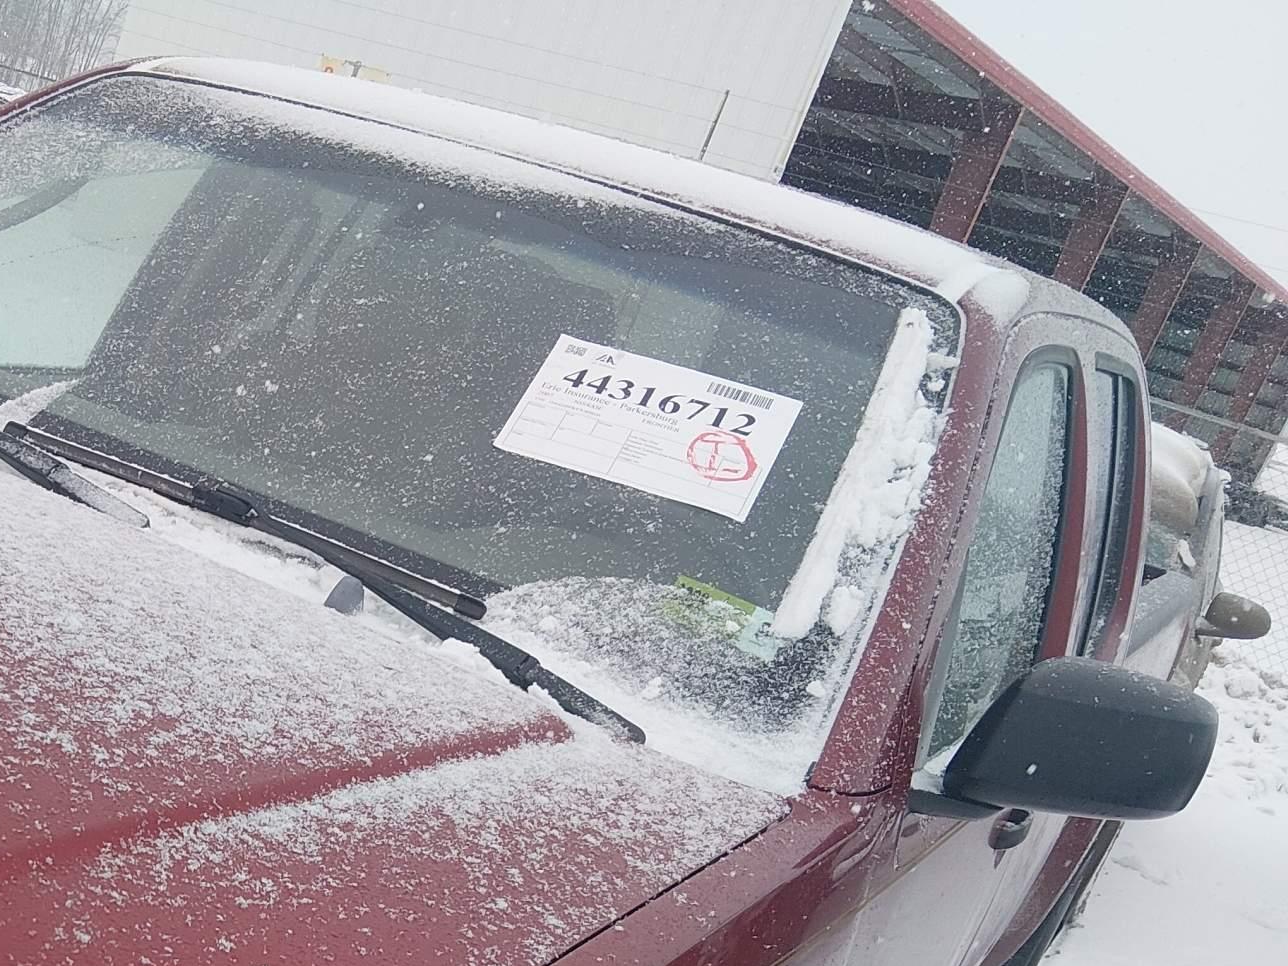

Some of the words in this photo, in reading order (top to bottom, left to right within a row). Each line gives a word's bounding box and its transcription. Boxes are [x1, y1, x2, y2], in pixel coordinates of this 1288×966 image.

[562, 368, 758, 437] 44316712
[562, 387, 610, 406] Insurance
[619, 402, 679, 426] Parkersburg
[641, 417, 681, 433] FRONTIER
